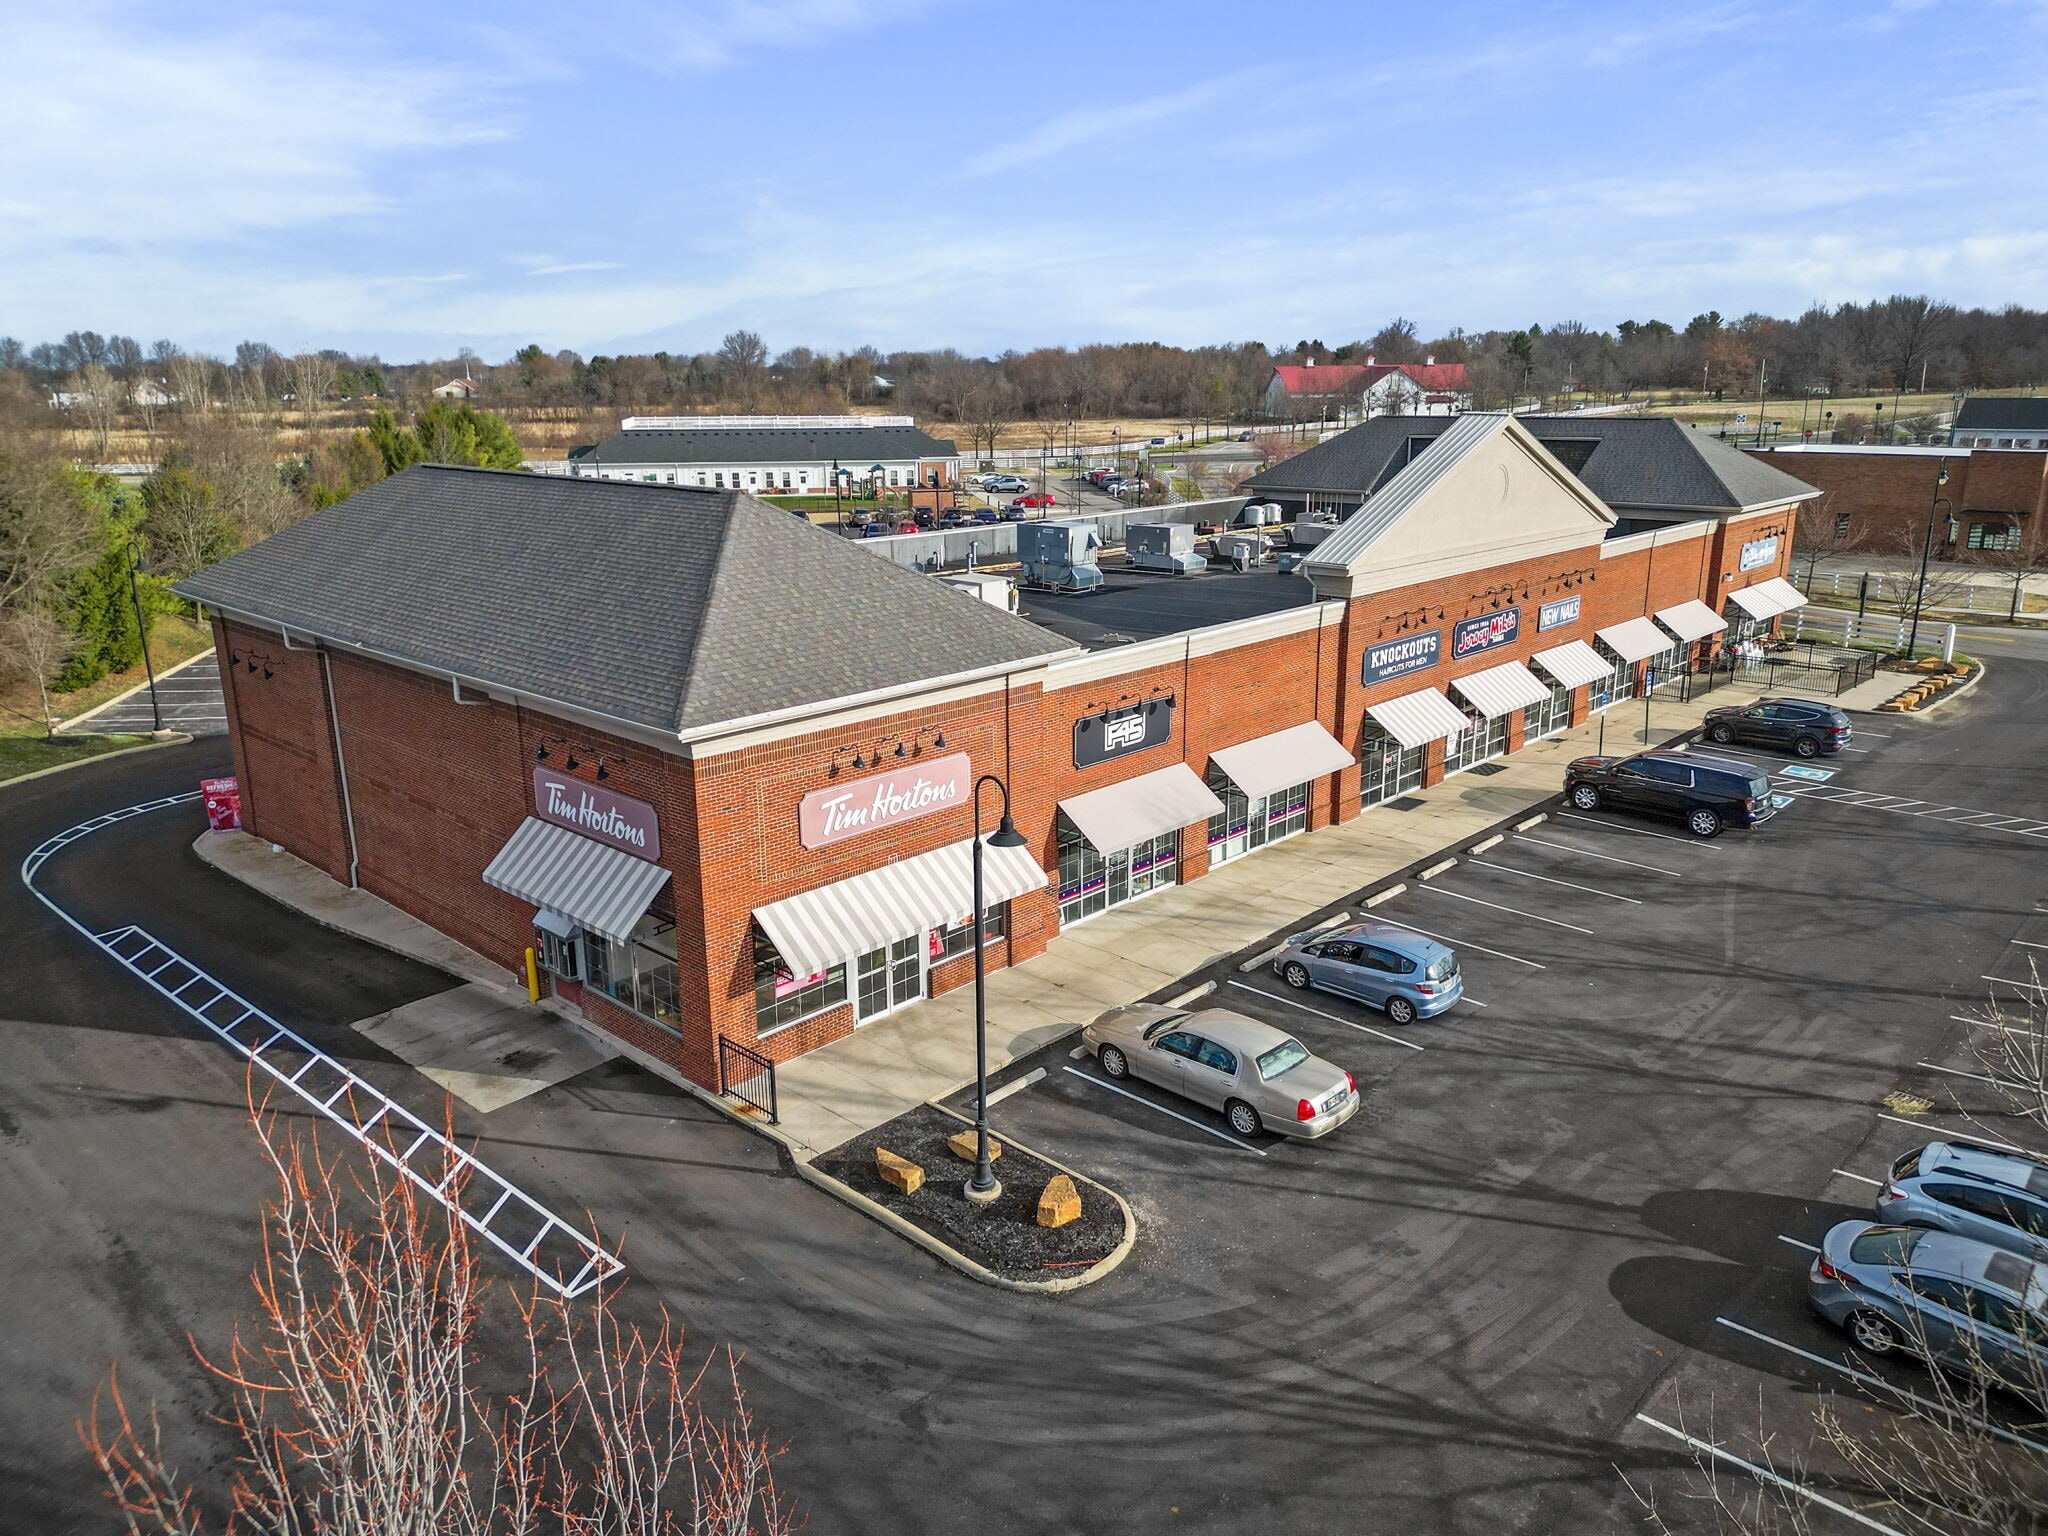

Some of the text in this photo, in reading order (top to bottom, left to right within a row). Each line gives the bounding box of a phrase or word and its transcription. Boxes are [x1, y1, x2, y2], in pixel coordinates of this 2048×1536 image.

[1458, 612, 1516, 653] Jersey Mike's
[1542, 601, 1579, 627] NEW NAILS
[1371, 636, 1436, 668] KNOCKOUTS
[1379, 656, 1427, 677] HAIRCUTS FOR MEN
[1105, 713, 1145, 750] F45
[545, 782, 645, 847] Tim Hortons
[821, 778, 956, 837] Tim Hortons
